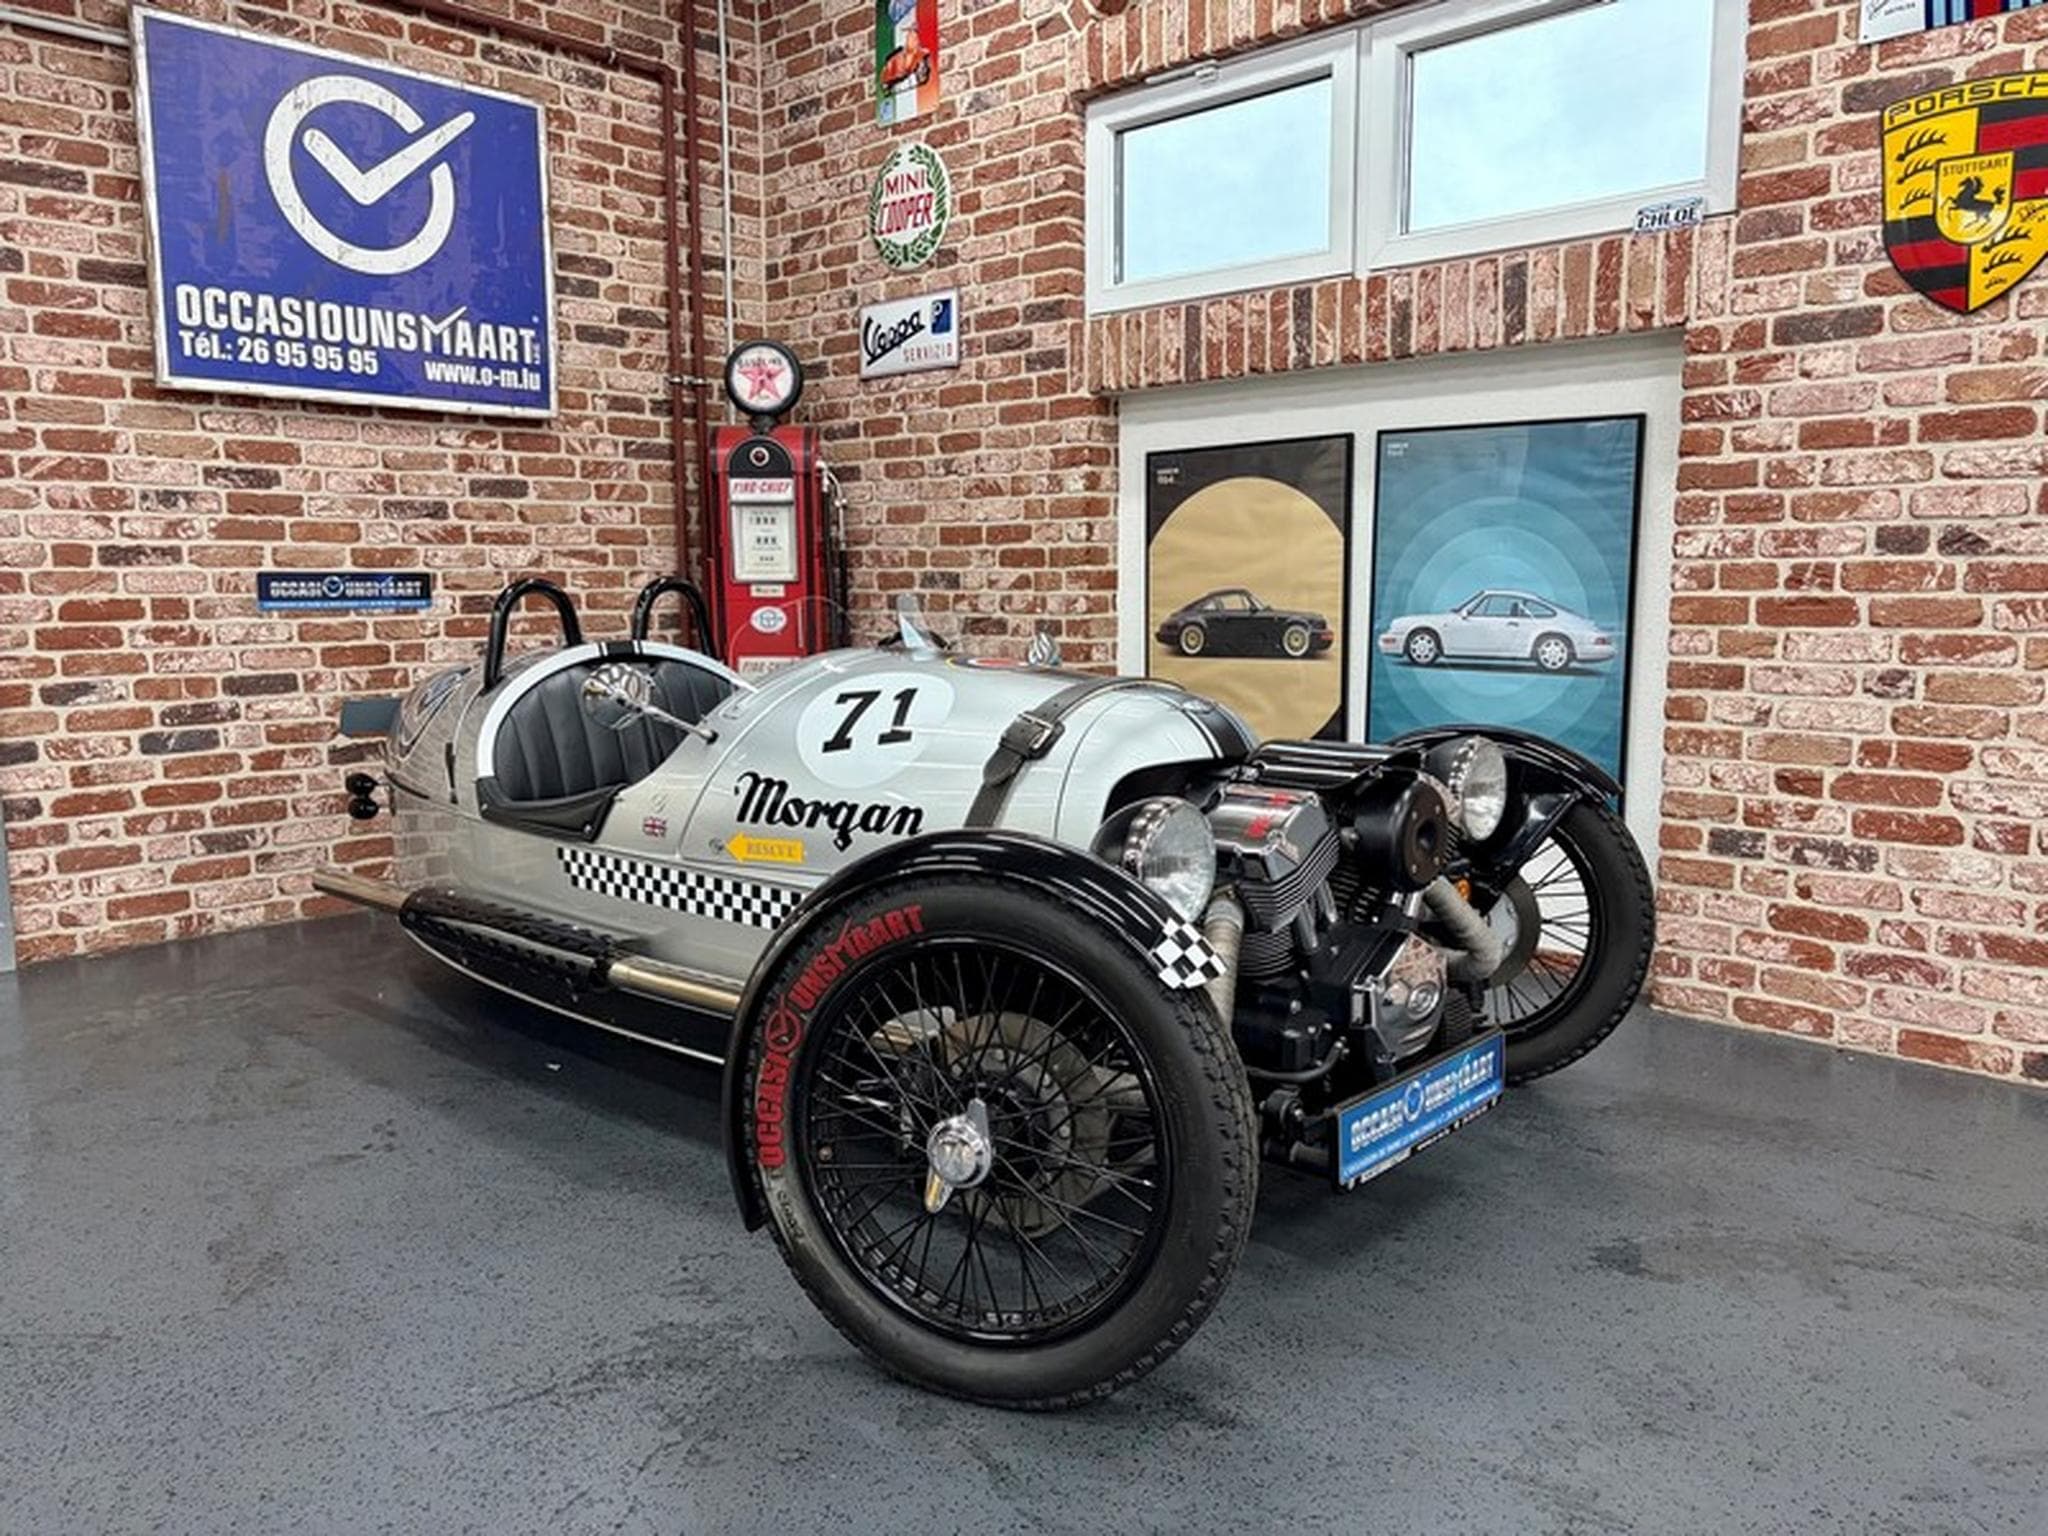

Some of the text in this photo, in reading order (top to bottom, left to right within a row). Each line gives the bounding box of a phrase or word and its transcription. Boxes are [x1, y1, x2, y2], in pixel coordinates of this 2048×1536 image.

[1889, 74, 2048, 125] PORSCH
[885, 169, 926, 197] MINI
[1942, 157, 2010, 178] STUTTGART
[878, 191, 934, 236] COOPER
[175, 283, 537, 365] OCCASIOUNSMAART
[237, 336, 270, 365] 26
[275, 340, 308, 369] 95
[312, 344, 344, 373] 95
[348, 350, 379, 376] 95
[424, 360, 542, 391] www.o-m.lu
[821, 687, 920, 754] 71
[734, 771, 924, 853] Morgan
[746, 840, 795, 858] RESCUE
